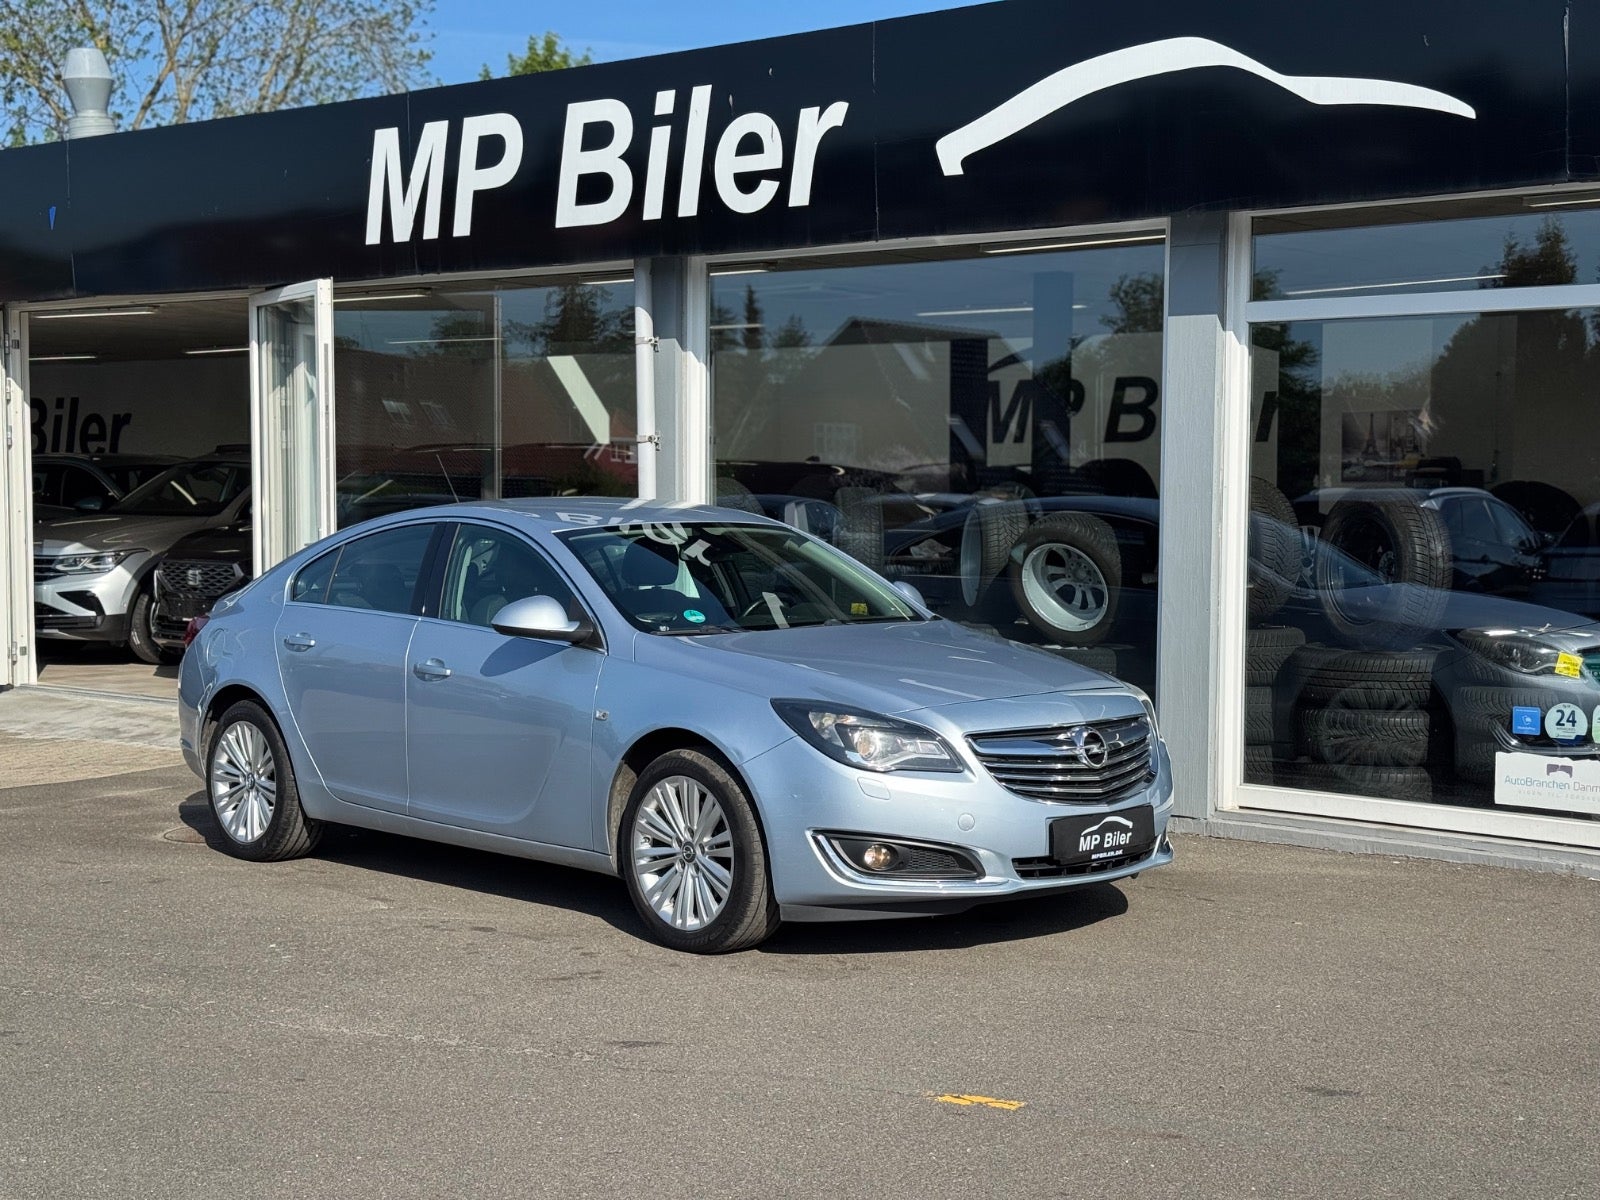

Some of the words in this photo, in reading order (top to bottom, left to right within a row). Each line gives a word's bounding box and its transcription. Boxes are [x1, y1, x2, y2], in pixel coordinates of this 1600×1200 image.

[366, 113, 524, 246] MP
[555, 84, 850, 229] Biler
[1555, 709, 1577, 728] 24
[1504, 775, 1570, 790] AutoBranchen
[1079, 834, 1101, 852] MP
[1104, 830, 1132, 848] Biler
